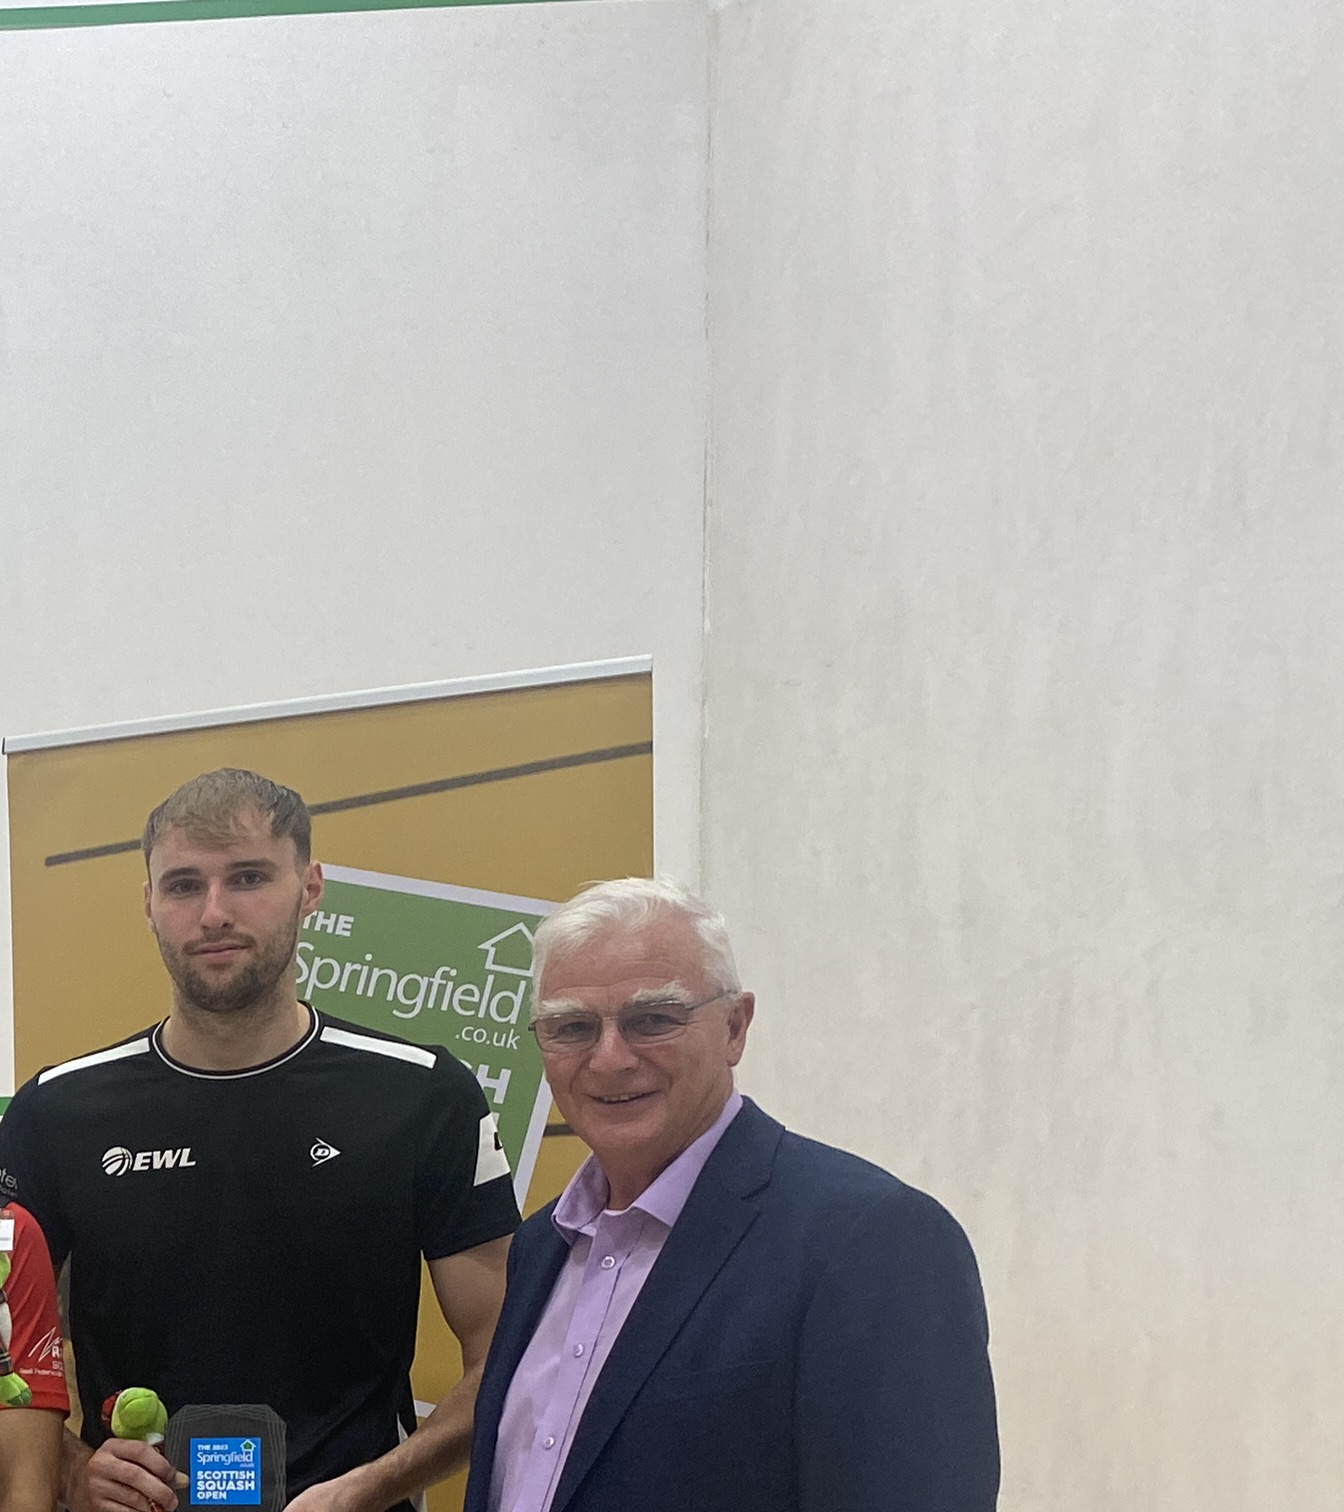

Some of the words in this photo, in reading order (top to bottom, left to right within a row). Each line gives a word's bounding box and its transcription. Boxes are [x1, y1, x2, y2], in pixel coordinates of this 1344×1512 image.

[302, 911, 354, 937] THE
[296, 942, 527, 1025] Springfield
[455, 1026, 521, 1050] .co.uk
[132, 1147, 196, 1171] EWL
[197, 1451, 253, 1465] Springfield
[197, 1470, 255, 1480] SCOTTISH
[197, 1480, 255, 1491] SQUASH
[197, 1491, 227, 1500] OPEN
